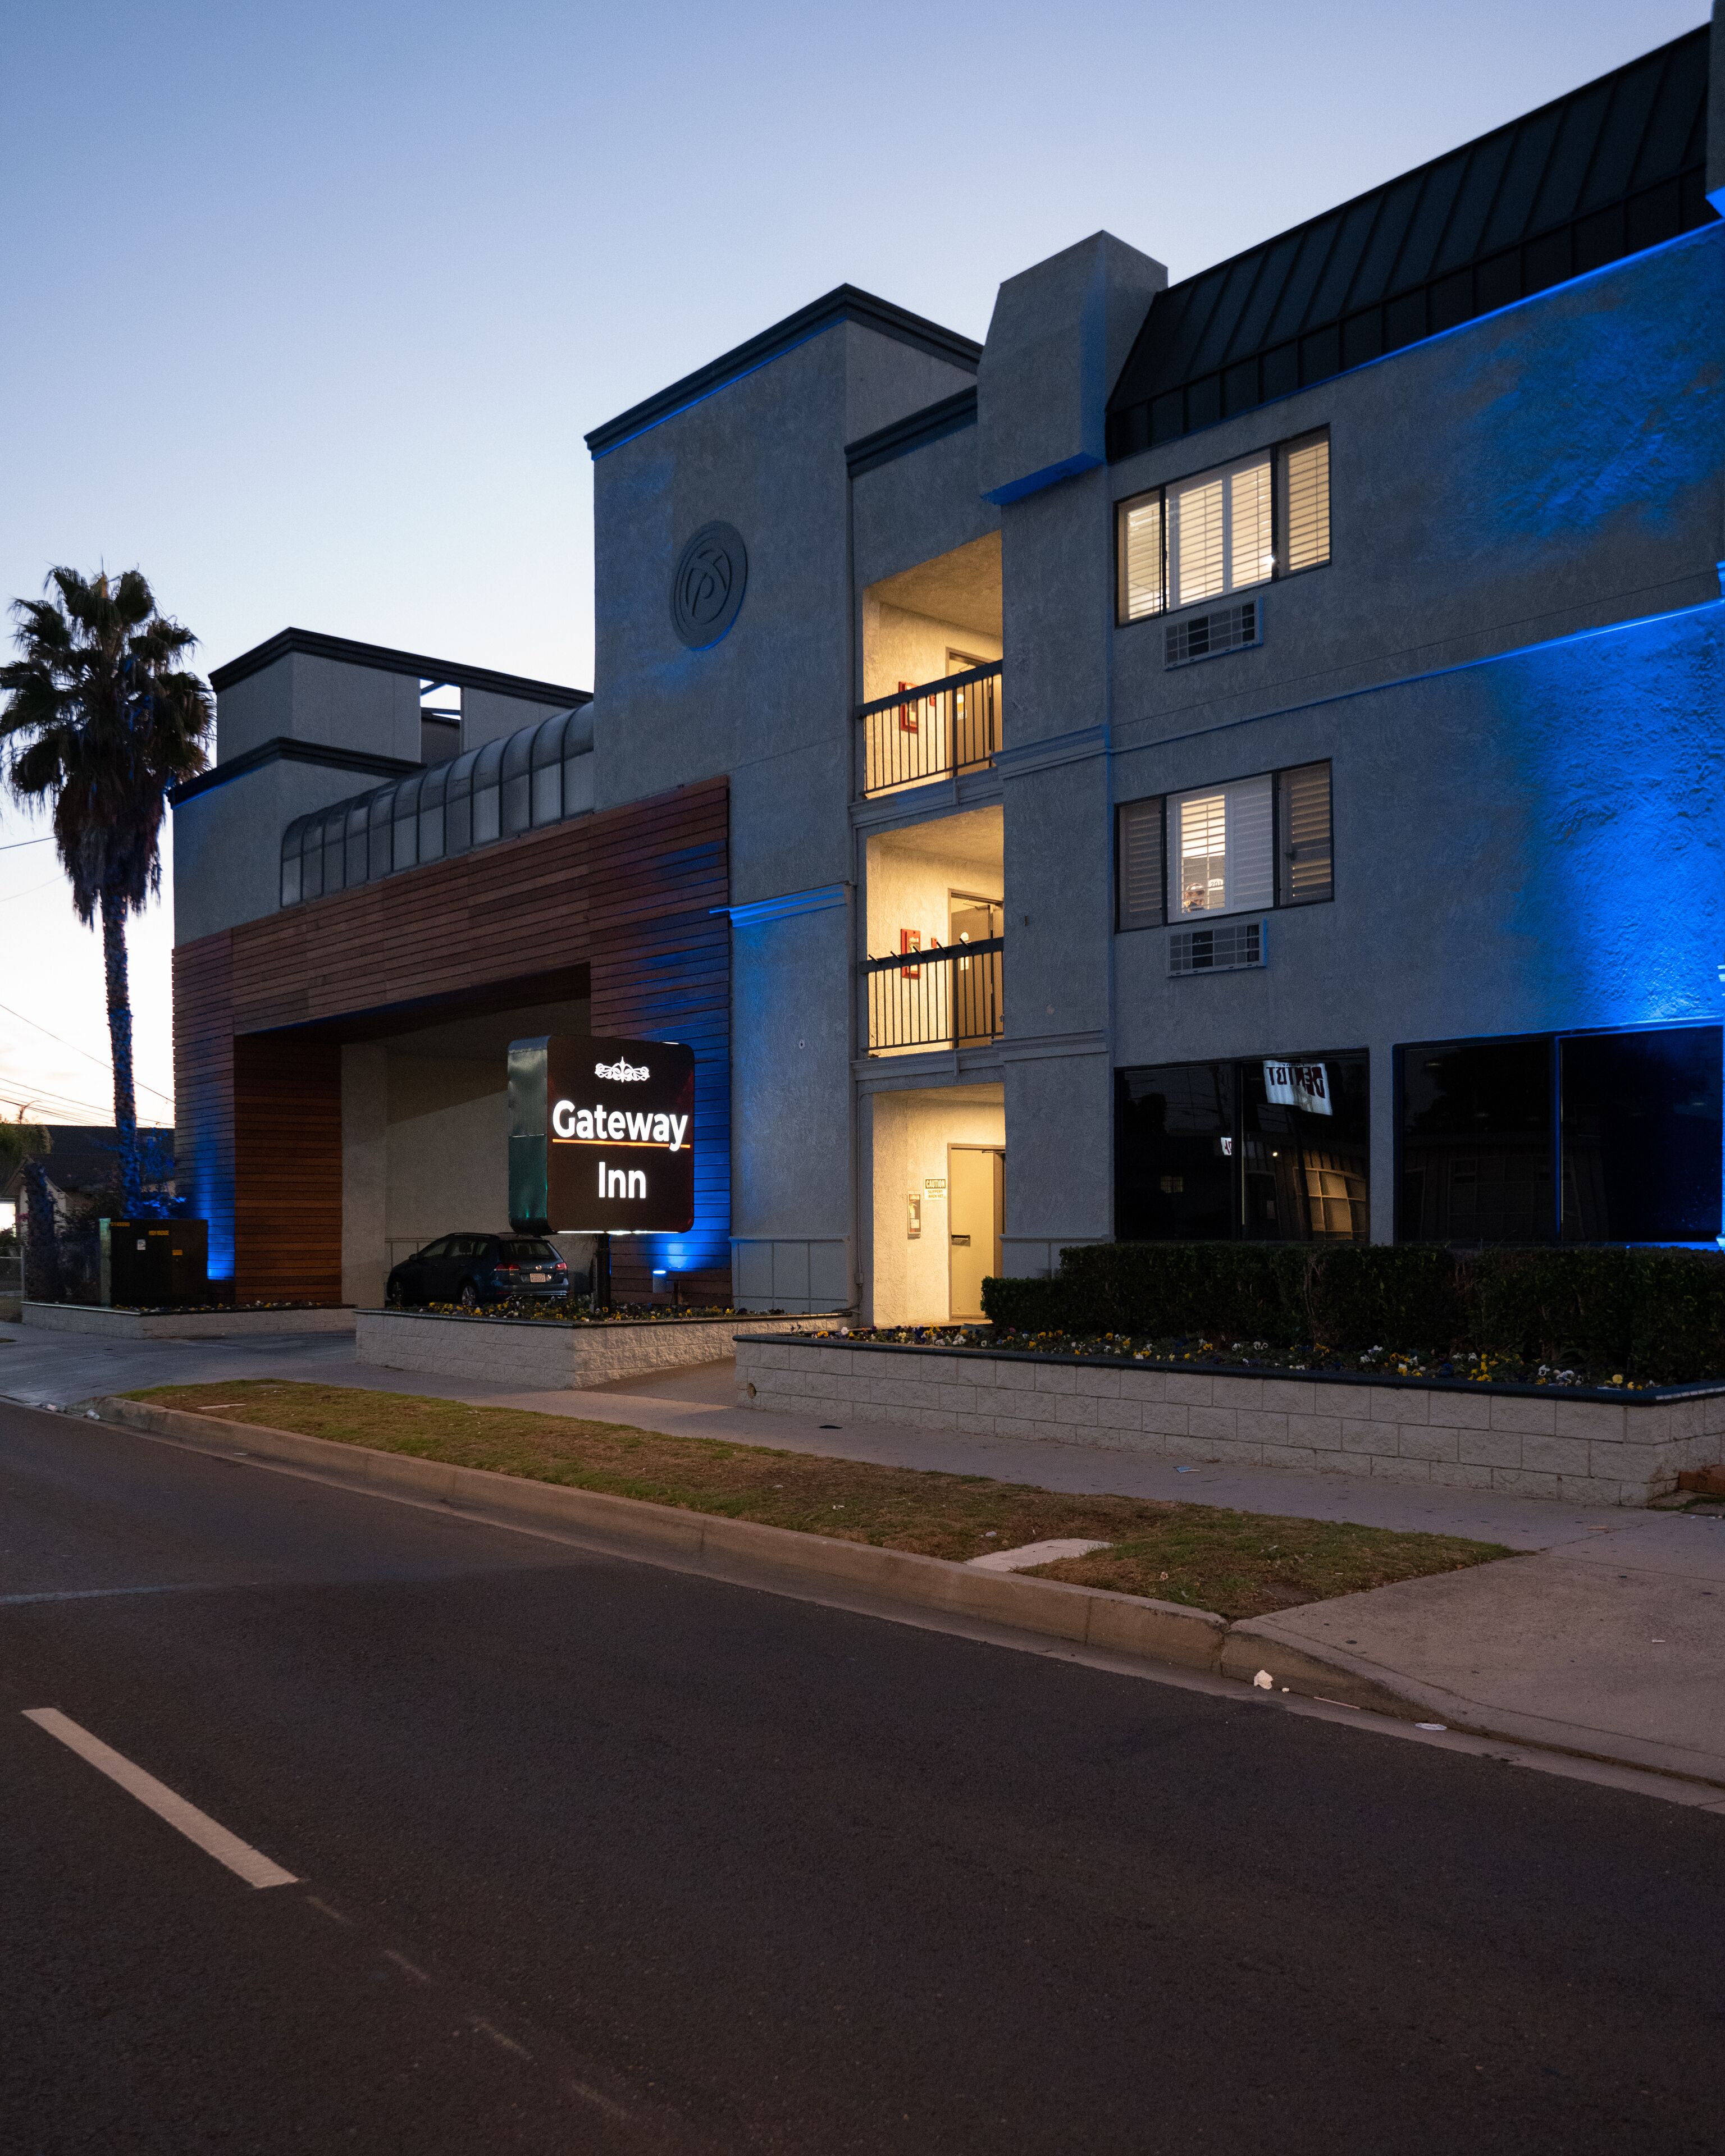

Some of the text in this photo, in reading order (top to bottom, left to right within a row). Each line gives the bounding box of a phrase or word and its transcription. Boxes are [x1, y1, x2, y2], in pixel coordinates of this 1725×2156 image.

[553, 1100, 688, 1152] Gateway
[599, 1162, 646, 1198] Inn
[926, 1180, 945, 1188] CAUTION
